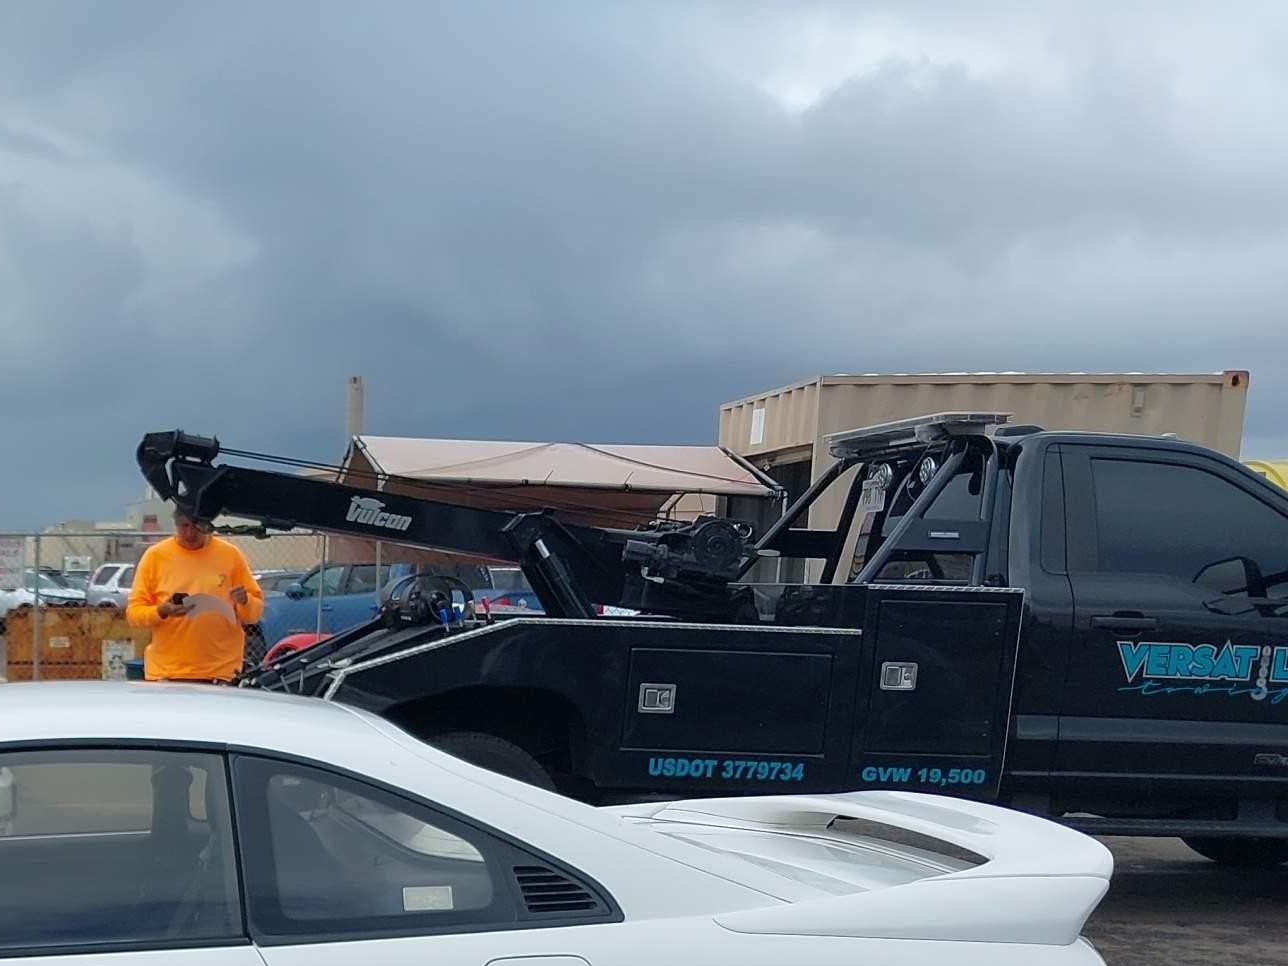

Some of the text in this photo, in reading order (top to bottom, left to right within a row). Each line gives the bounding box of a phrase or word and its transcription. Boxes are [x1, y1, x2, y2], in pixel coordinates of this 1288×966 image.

[345, 499, 413, 531] Vulcan
[648, 757, 805, 782] USDOT 3779734
[861, 766, 987, 787] GVW 19,500
